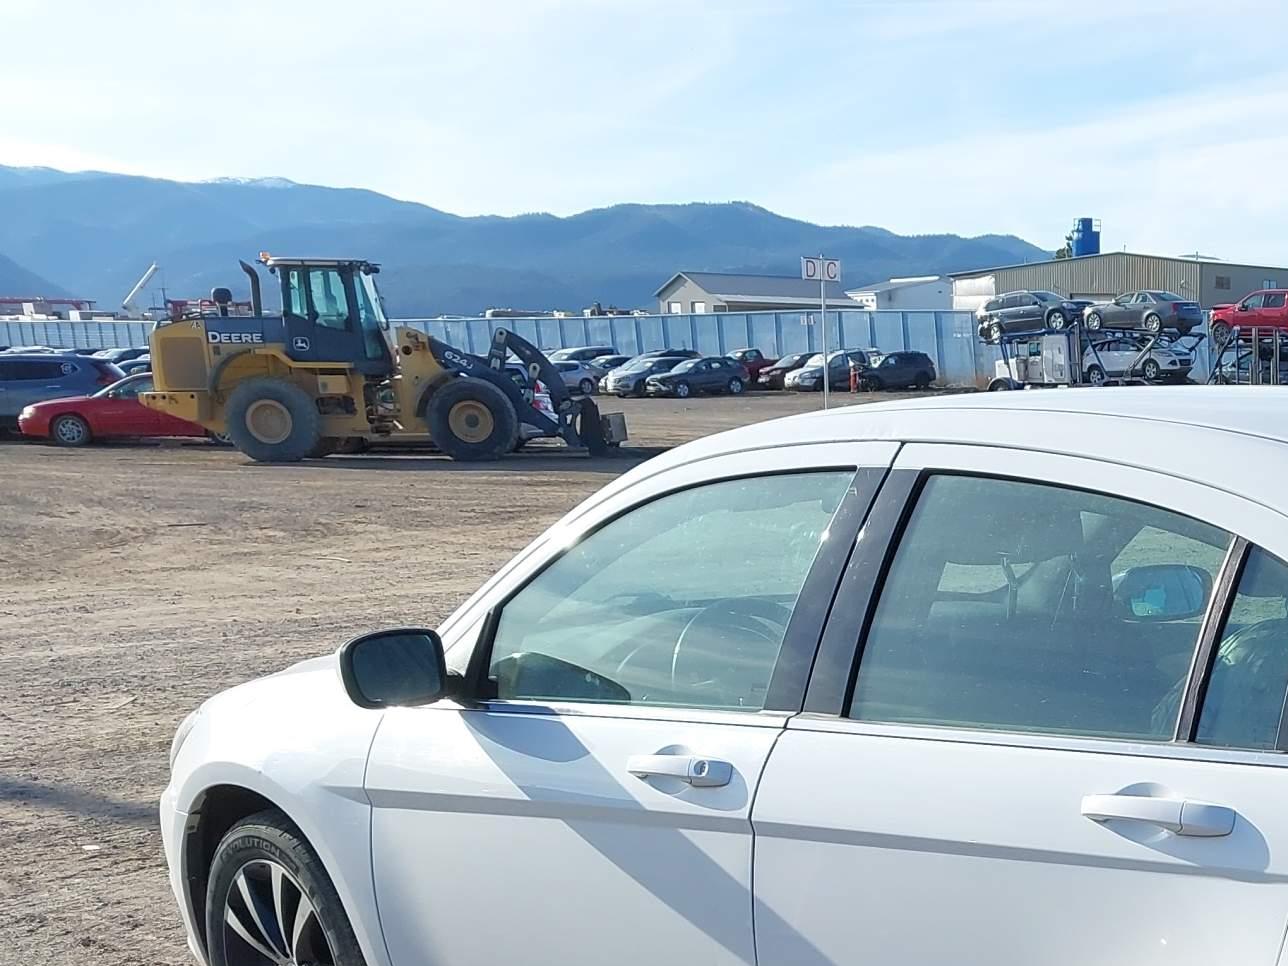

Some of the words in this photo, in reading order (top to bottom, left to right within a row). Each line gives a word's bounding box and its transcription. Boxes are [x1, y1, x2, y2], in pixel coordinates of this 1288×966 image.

[806, 260, 816, 278] D
[827, 262, 837, 279] C
[207, 331, 264, 343] DEERE
[220, 836, 280, 862] EVOLUTION
